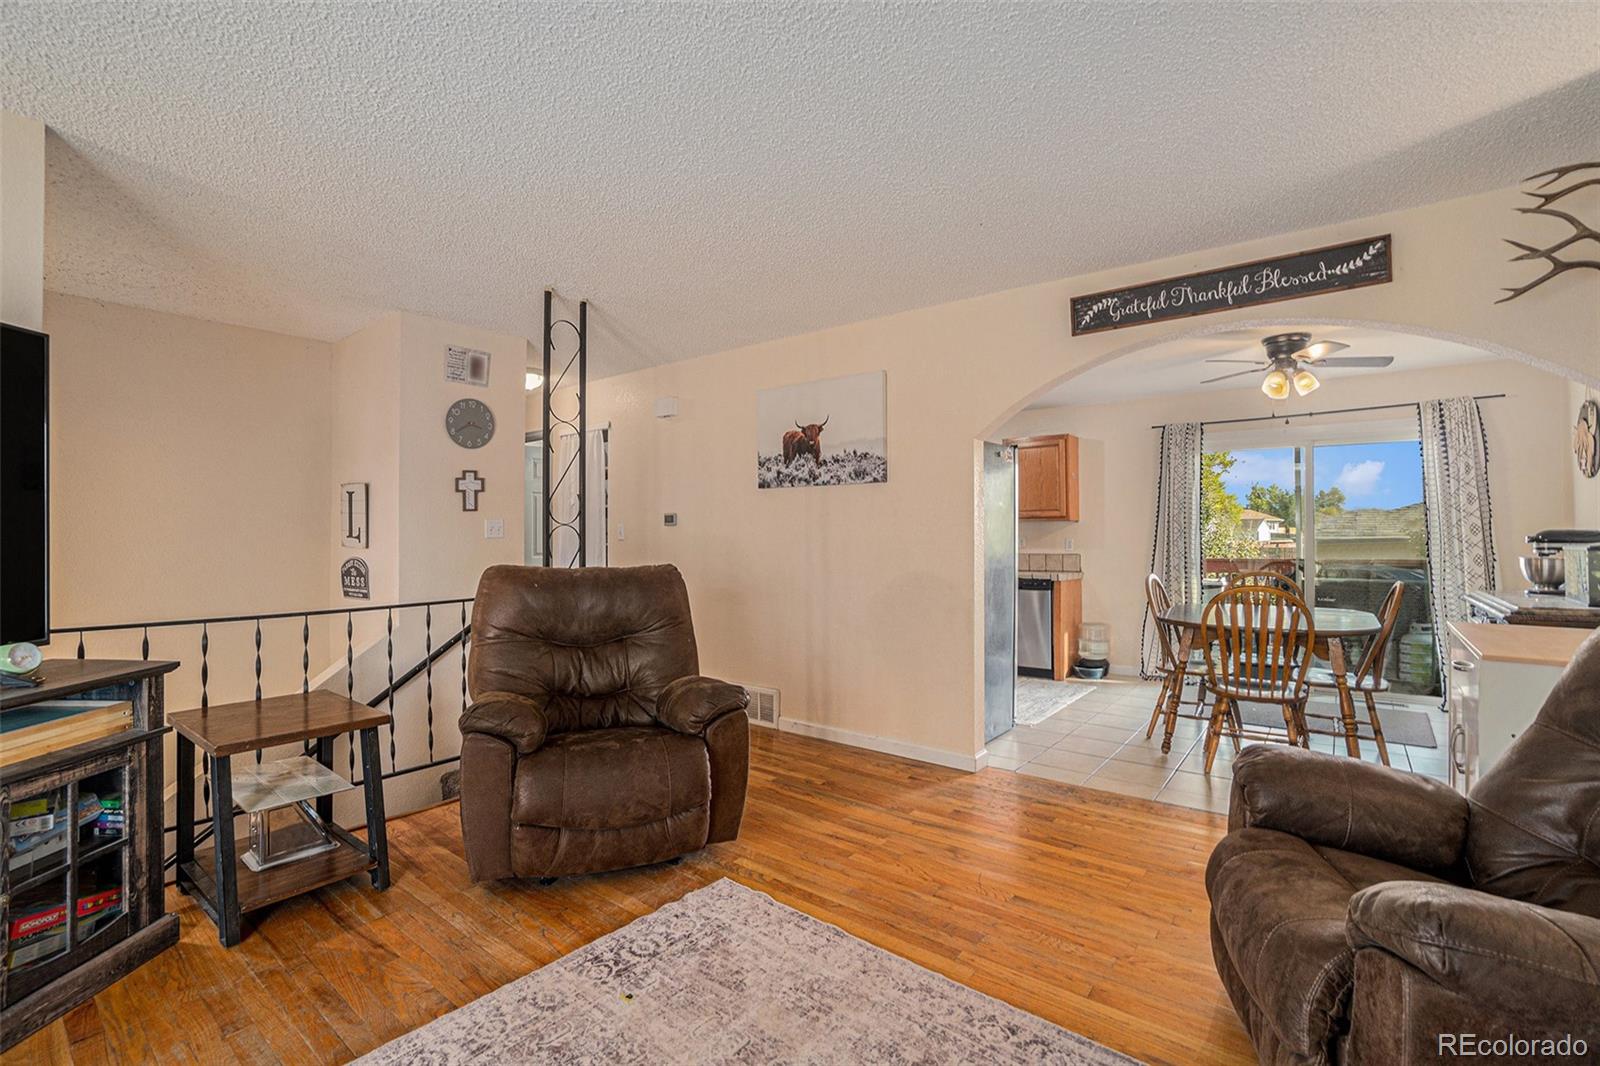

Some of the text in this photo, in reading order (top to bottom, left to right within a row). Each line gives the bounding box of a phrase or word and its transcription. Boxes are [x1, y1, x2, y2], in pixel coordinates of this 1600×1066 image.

[1109, 261, 1327, 321] Grateful Thankful Blessed
[346, 491, 361, 544] L
[343, 576, 366, 587] MESS
